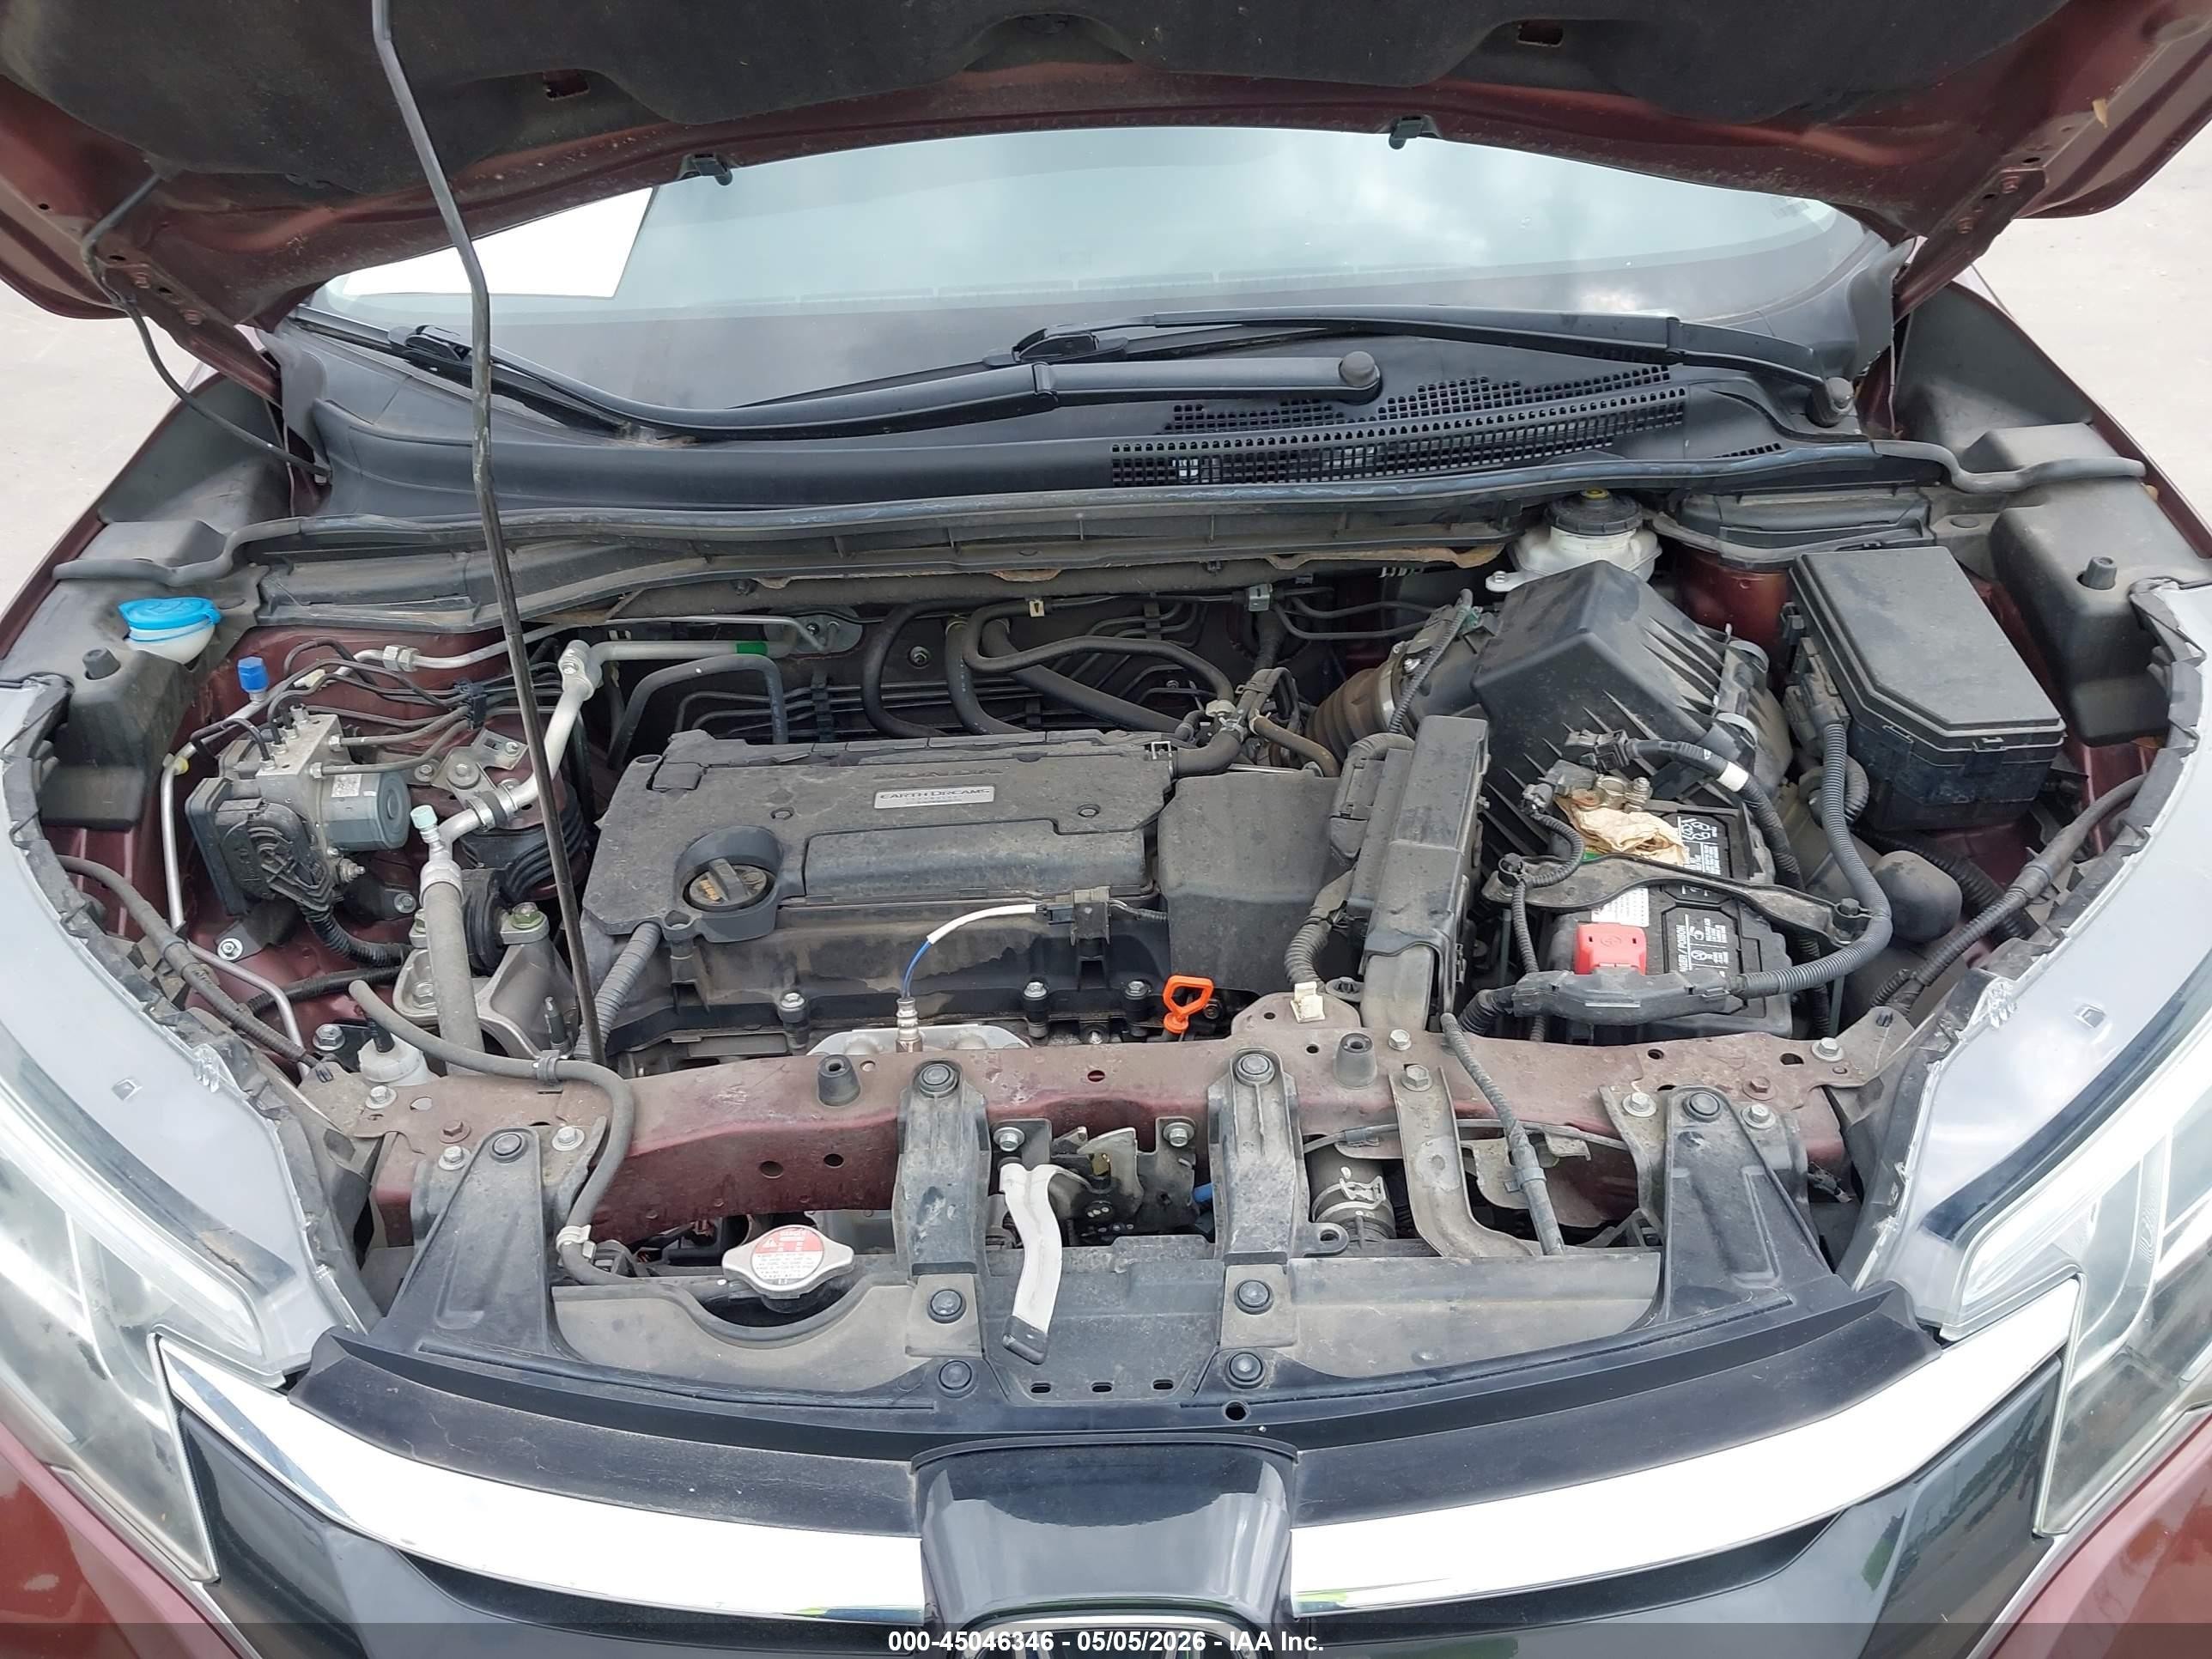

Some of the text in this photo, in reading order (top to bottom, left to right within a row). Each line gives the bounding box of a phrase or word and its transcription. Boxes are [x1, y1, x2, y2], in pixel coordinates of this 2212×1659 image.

[931, 788, 990, 797] DREAMS
[1675, 925, 1686, 948] POISON
[1677, 954, 1688, 972] NGER
